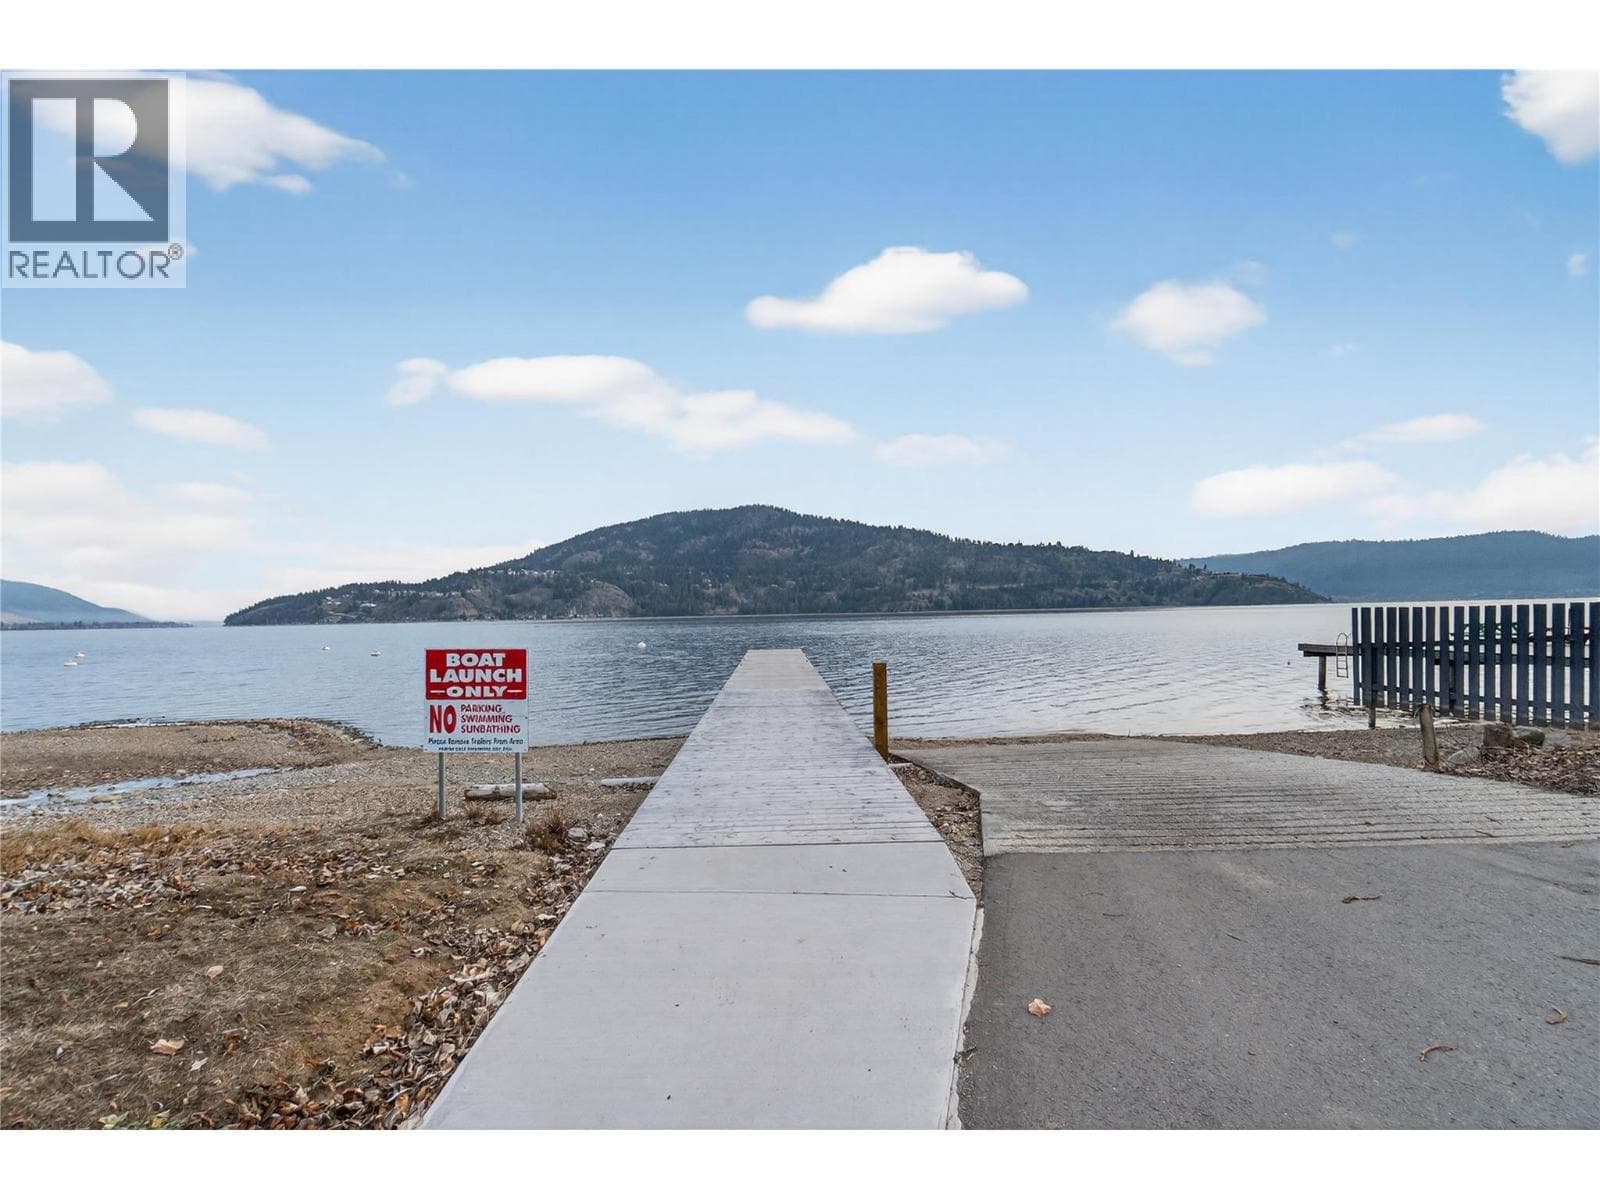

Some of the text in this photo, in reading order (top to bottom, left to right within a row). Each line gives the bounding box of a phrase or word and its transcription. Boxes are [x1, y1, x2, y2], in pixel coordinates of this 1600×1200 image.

[446, 652, 506, 667] BOAT
[430, 668, 522, 683] LAUNCH
[460, 704, 503, 713] PARKING
[429, 704, 457, 734] NO
[460, 714, 513, 723] SWIMMING
[460, 724, 521, 734] SUNBATHING
